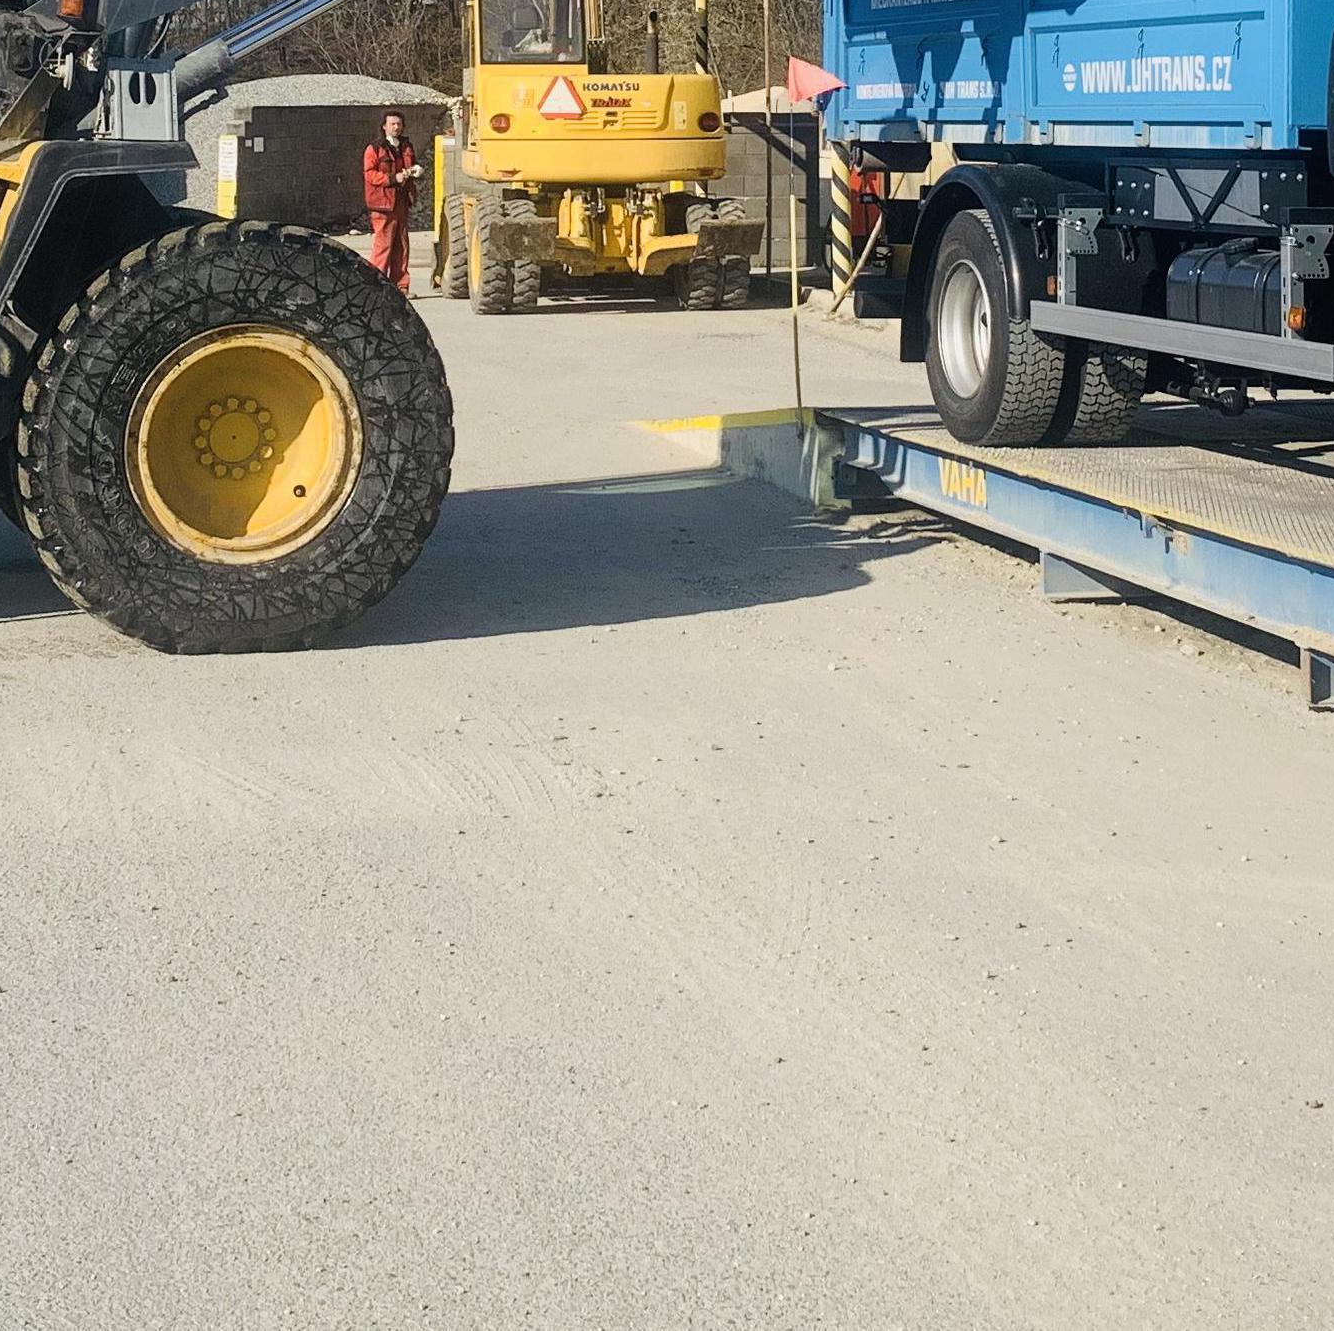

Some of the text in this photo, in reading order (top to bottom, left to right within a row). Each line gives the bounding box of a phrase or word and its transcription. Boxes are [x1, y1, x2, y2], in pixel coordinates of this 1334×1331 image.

[582, 80, 640, 92] KOMATSU
[1079, 54, 1234, 95] WWW.UHTRANS.CZ
[938, 456, 988, 509] VAHA
